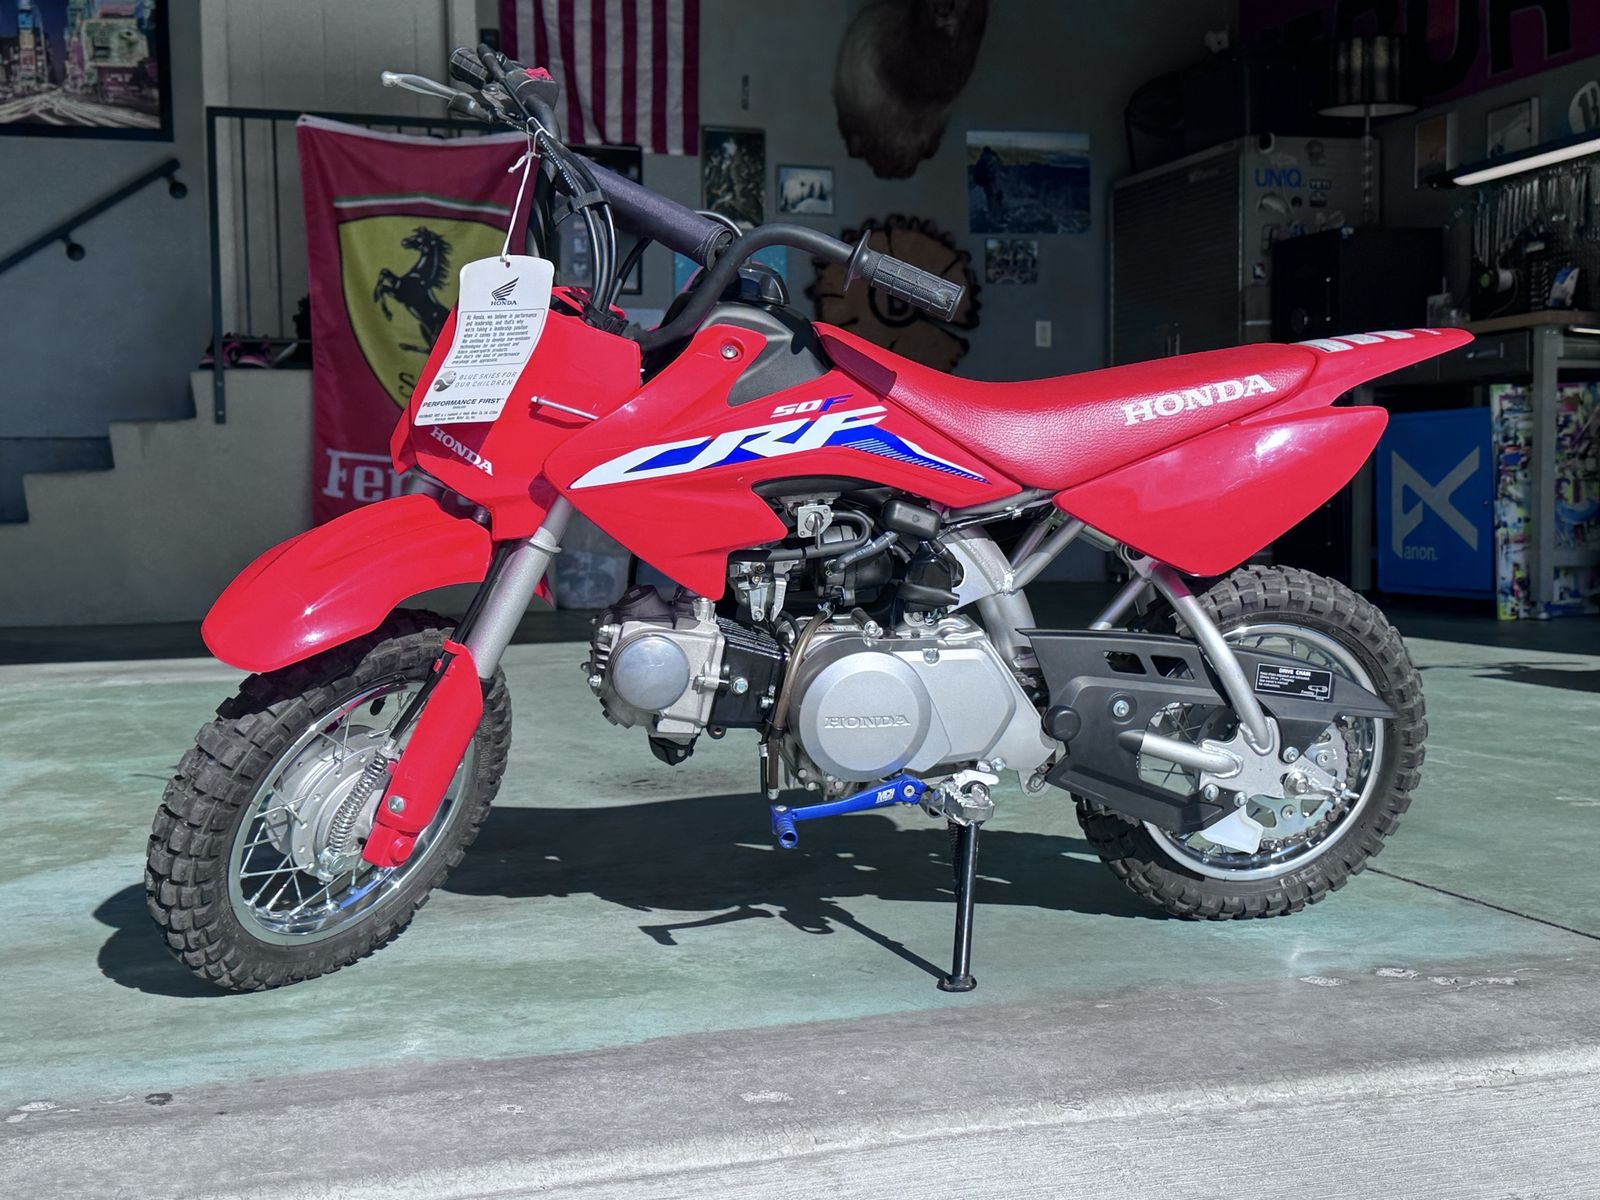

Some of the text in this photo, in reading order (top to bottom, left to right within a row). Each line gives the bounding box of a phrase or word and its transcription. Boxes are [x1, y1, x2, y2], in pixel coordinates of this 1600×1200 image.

[422, 399, 476, 407] PERFORMANCE
[770, 394, 854, 418] 50F
[1120, 374, 1276, 426] HONDA
[430, 426, 494, 476] HONDA
[568, 405, 887, 489] CRF
[824, 714, 912, 729] HONDA
